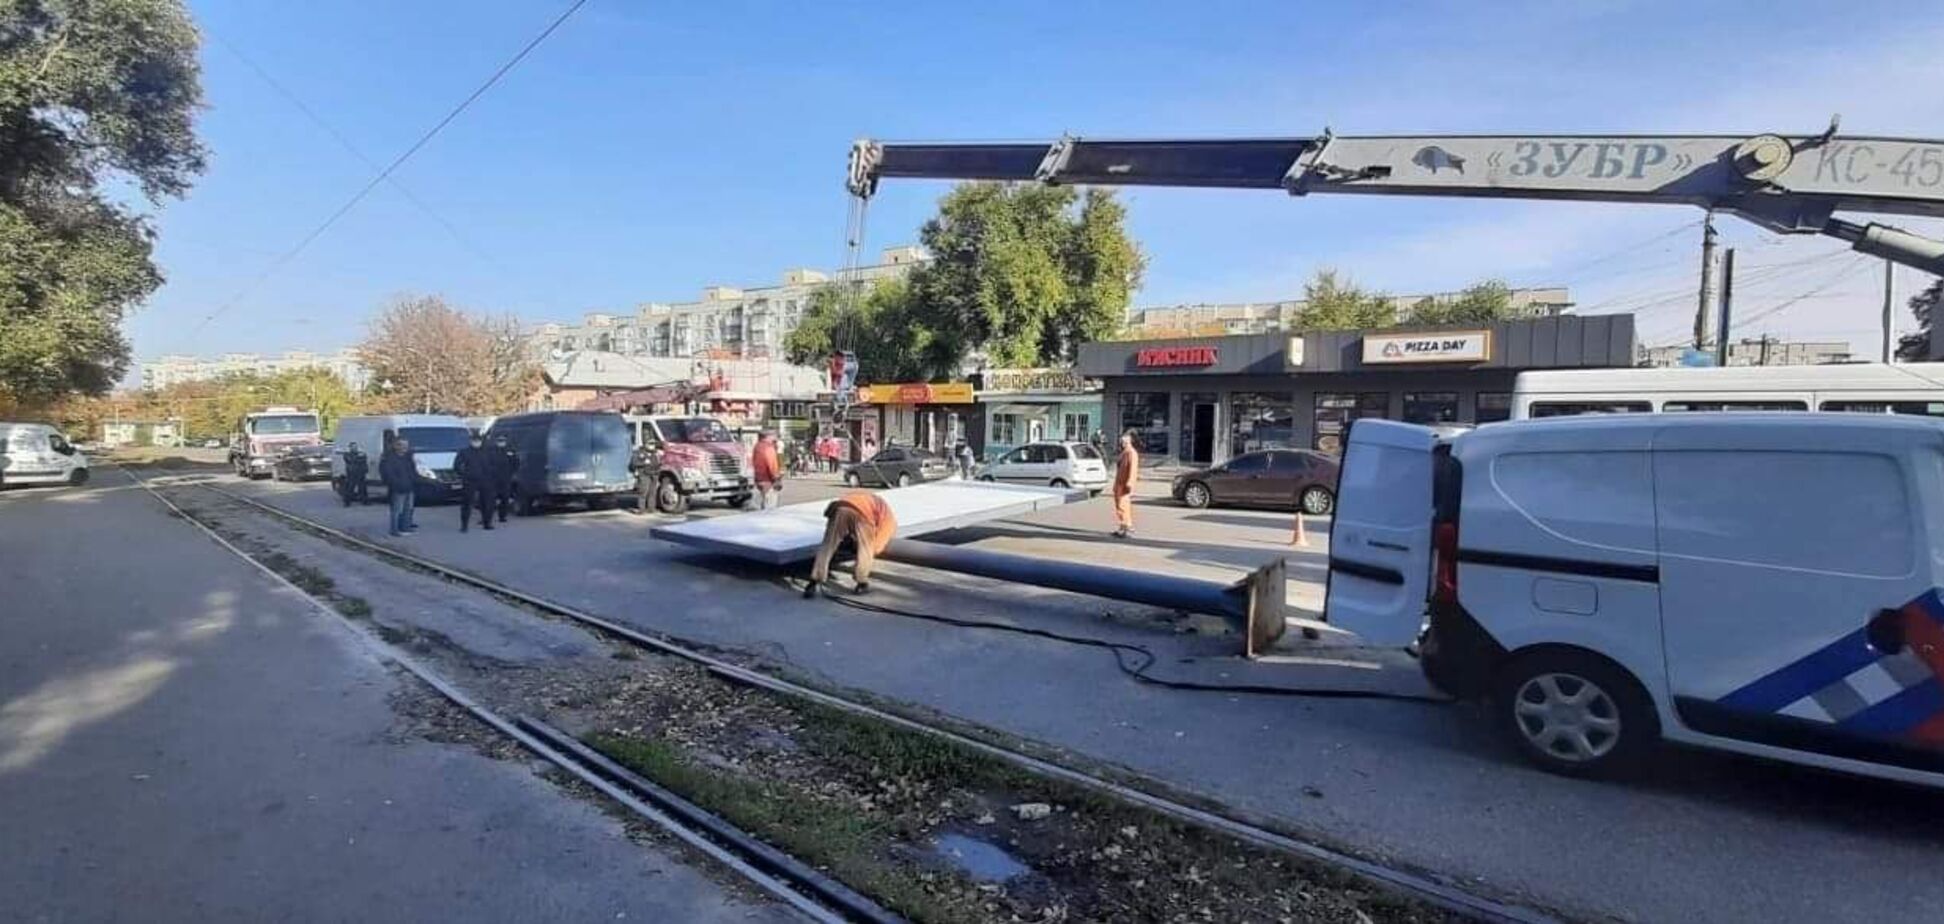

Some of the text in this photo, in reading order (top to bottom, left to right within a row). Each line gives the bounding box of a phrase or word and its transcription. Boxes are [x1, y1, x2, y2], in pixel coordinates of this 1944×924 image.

[1486, 141, 1693, 179] «ЗУБР»
[1404, 339, 1467, 352] PIZZA DAY
